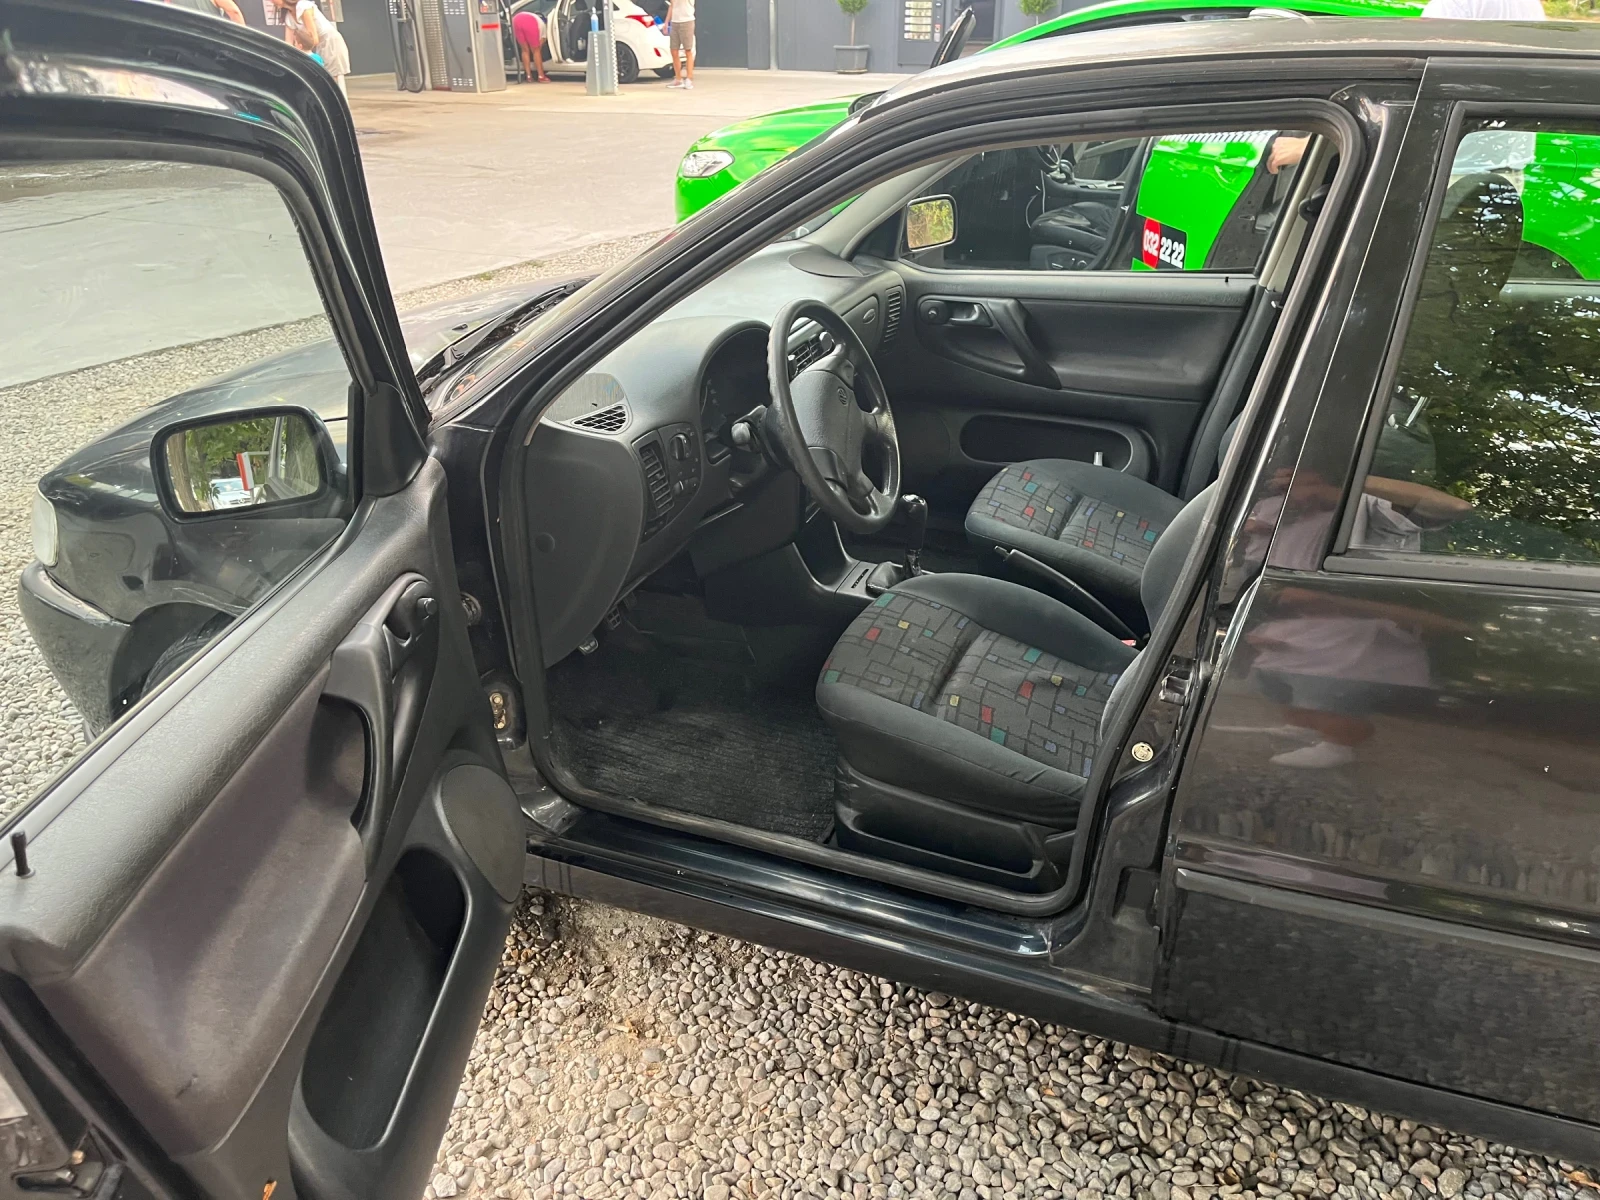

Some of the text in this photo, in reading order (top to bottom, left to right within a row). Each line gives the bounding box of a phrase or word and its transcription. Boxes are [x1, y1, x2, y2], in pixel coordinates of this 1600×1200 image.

[1144, 229, 1184, 269] 032 22 22
